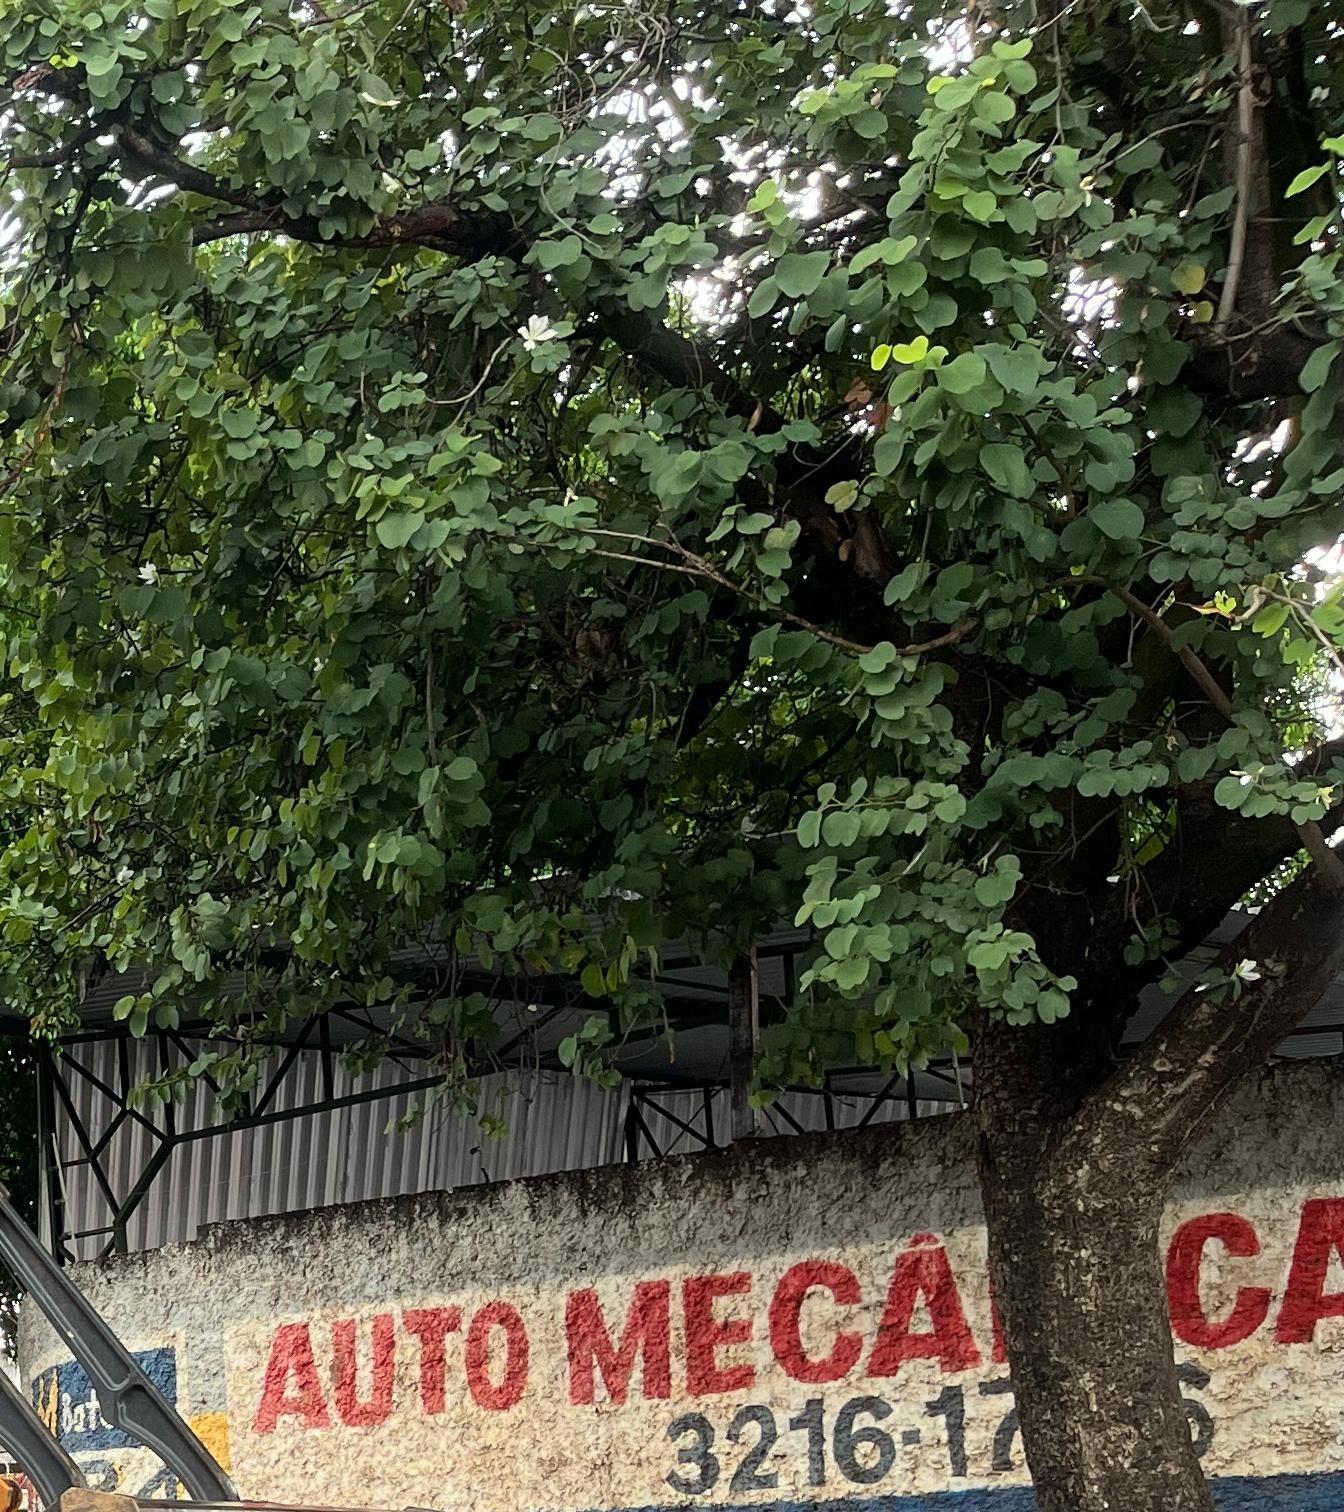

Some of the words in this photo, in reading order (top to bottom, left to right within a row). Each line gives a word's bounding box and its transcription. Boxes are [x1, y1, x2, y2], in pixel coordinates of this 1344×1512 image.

[251, 1301, 530, 1433] AUTO
[565, 1198, 1344, 1405] MECÂCA
[665, 1362, 1213, 1496] 3216-17
